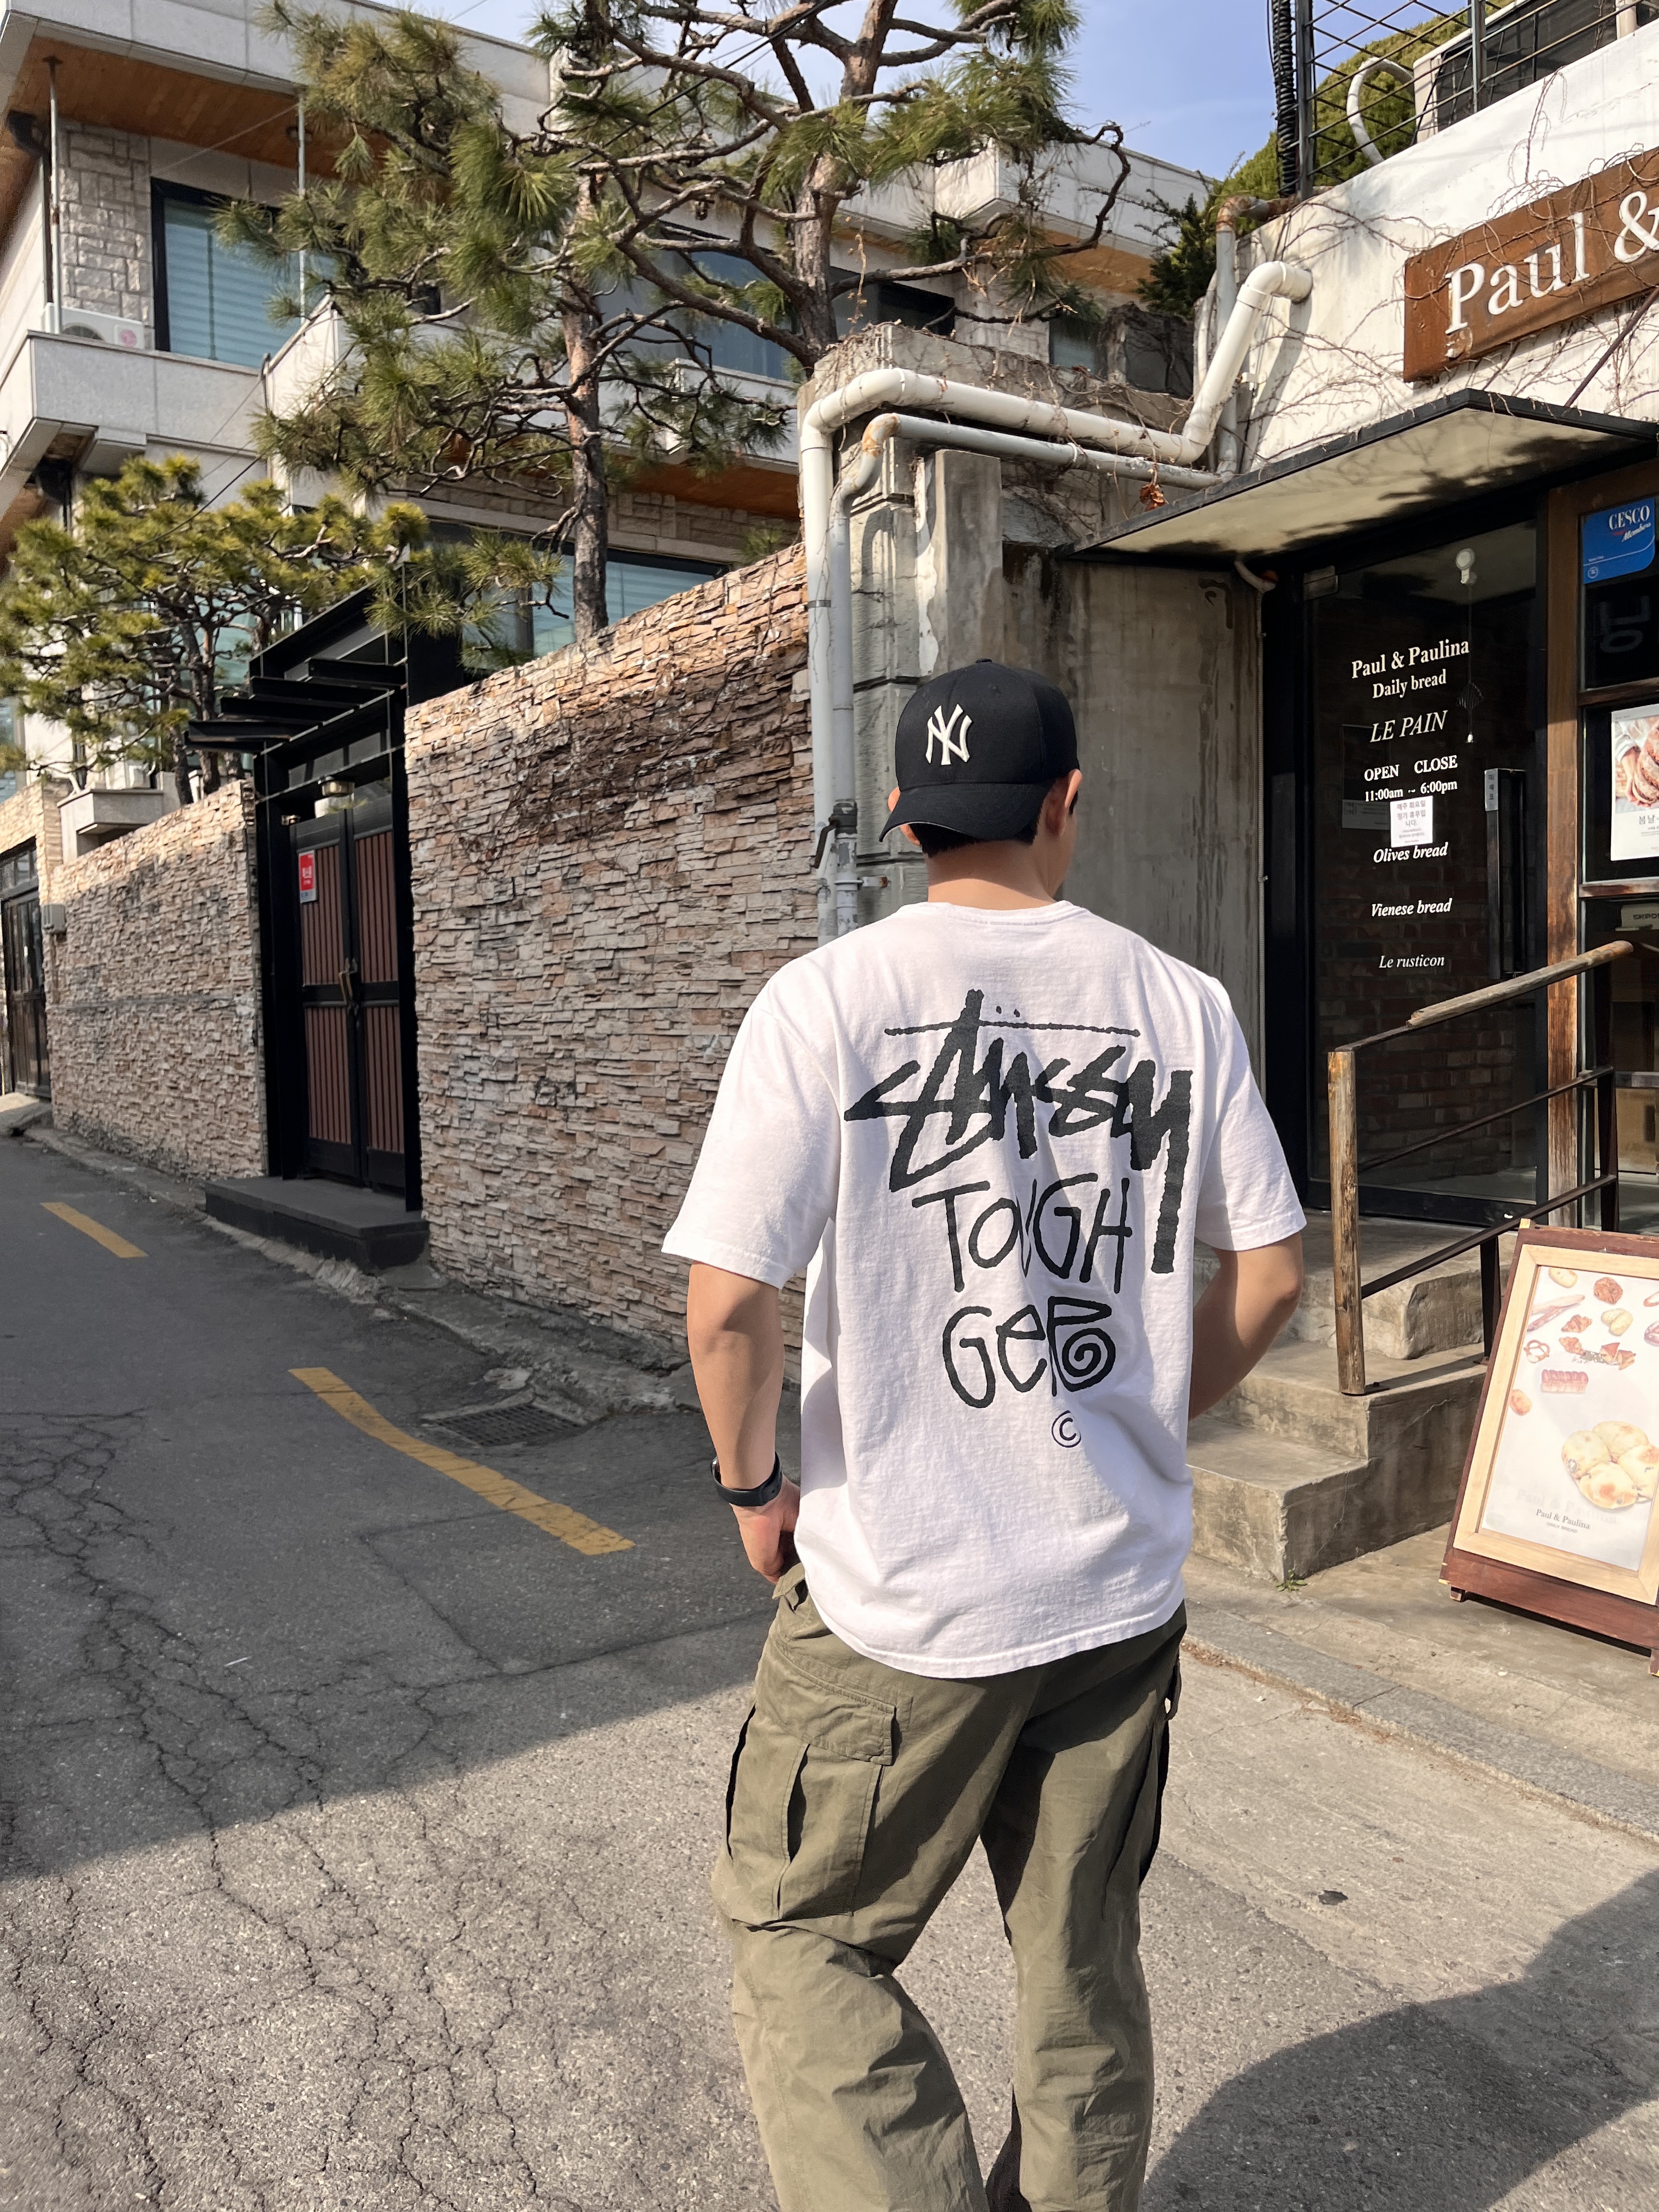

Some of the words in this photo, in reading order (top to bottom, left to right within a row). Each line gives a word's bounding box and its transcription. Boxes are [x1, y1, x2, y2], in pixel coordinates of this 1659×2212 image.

[1445, 212, 1590, 335] Paul
[1613, 191, 1659, 263] &
[1609, 505, 1650, 531] CESCO
[1351, 654, 1386, 679] Paul
[1391, 651, 1404, 670] &
[1408, 639, 1470, 666] Paulina
[1372, 679, 1408, 698] Daily
[1410, 668, 1447, 690] bread
[926, 704, 972, 765] NY
[1370, 719, 1396, 743] LE
[1399, 710, 1449, 737] PAIN
[1364, 764, 1400, 781] OPEN
[1414, 755, 1458, 774] CLOSE
[1365, 788, 1403, 802] 11:00am
[1420, 781, 1458, 794] 6:00pm
[1409, 800, 1426, 808] 화요일
[1373, 849, 1410, 863] Olives
[1413, 842, 1448, 859] bread
[1372, 903, 1414, 917] Vienese
[1417, 898, 1453, 914] bread
[1379, 955, 1393, 968] Le
[1396, 954, 1444, 968] rusticon
[1536, 1508, 1552, 1519] Paul
[1553, 1514, 1560, 1522] &
[1562, 1515, 1590, 1530] Paulina
